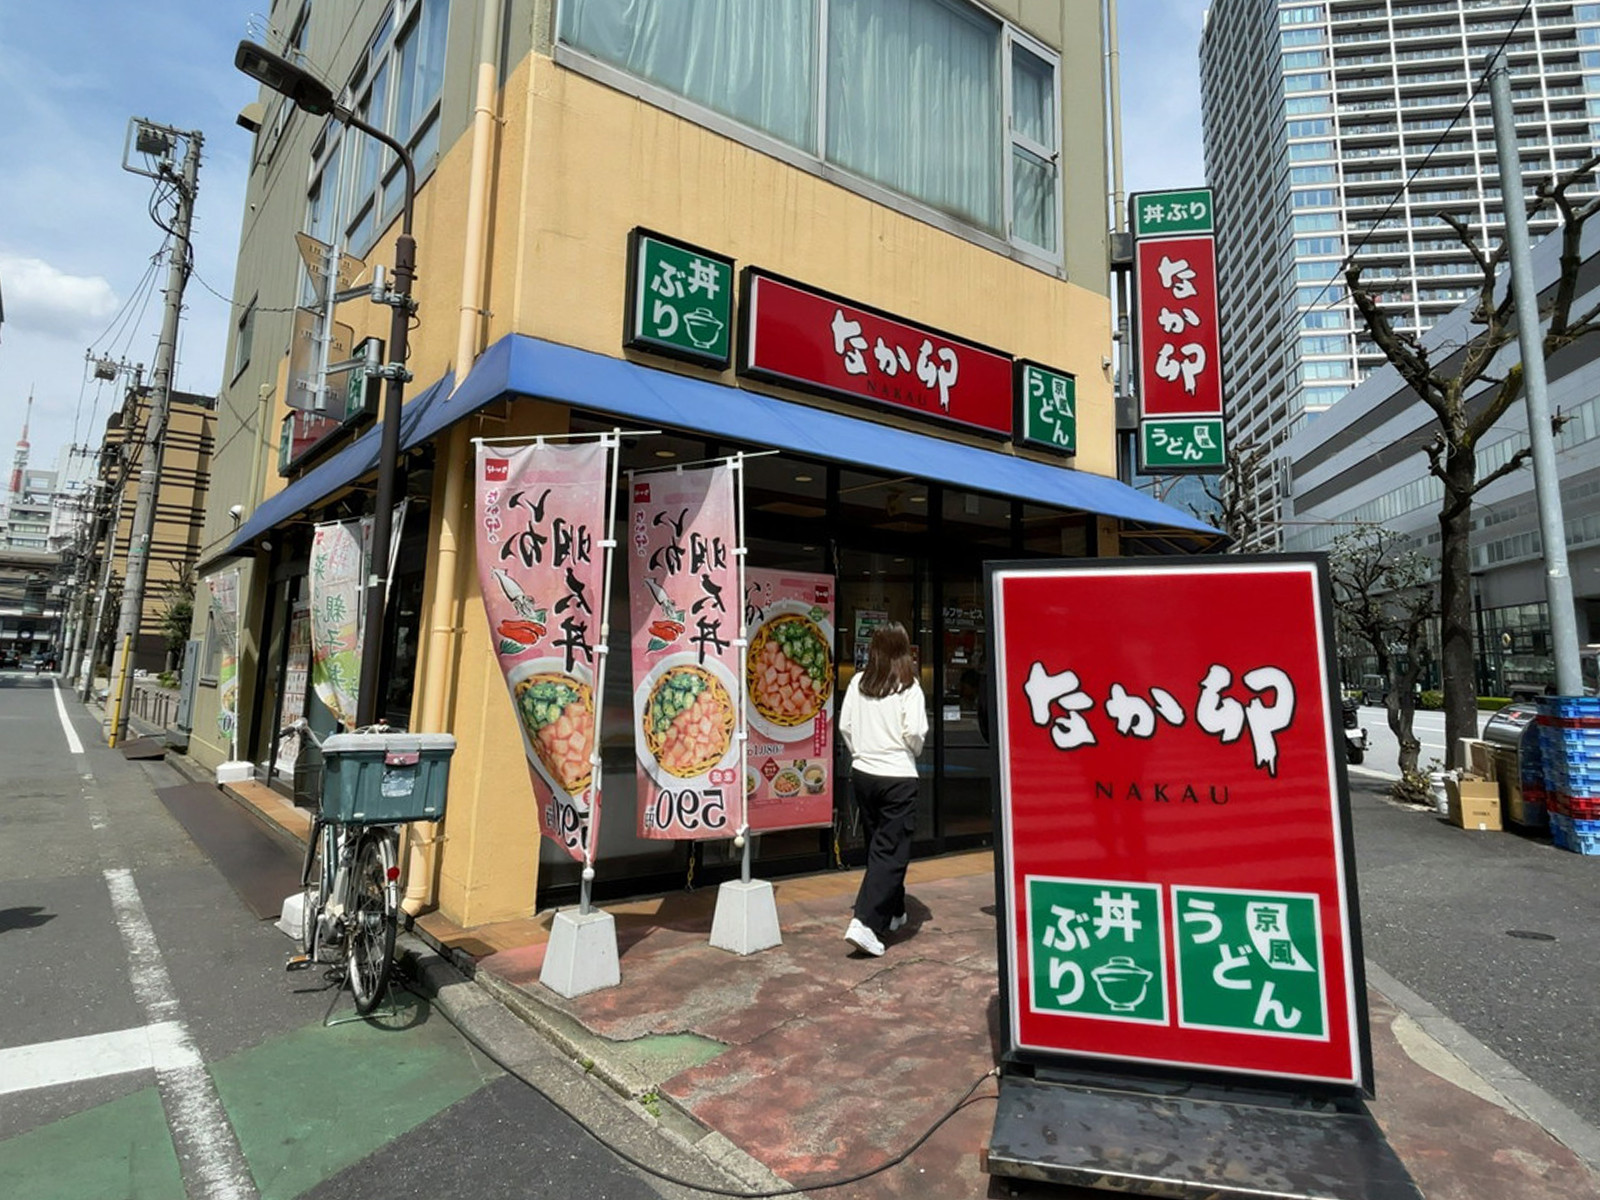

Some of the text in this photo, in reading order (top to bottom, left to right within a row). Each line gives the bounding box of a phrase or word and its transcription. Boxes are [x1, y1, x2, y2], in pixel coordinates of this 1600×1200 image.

[1143, 201, 1206, 224] 丼ぶり
[831, 309, 959, 412] なか卯
[1155, 256, 1206, 396] なか卯
[1030, 371, 1069, 445] うどん
[1151, 428, 1203, 461] うどん
[1023, 660, 1296, 777] なか卯
[1096, 781, 1230, 806] NAKAU
[1182, 898, 1302, 1029] うどん
[1253, 906, 1296, 967] 京風
